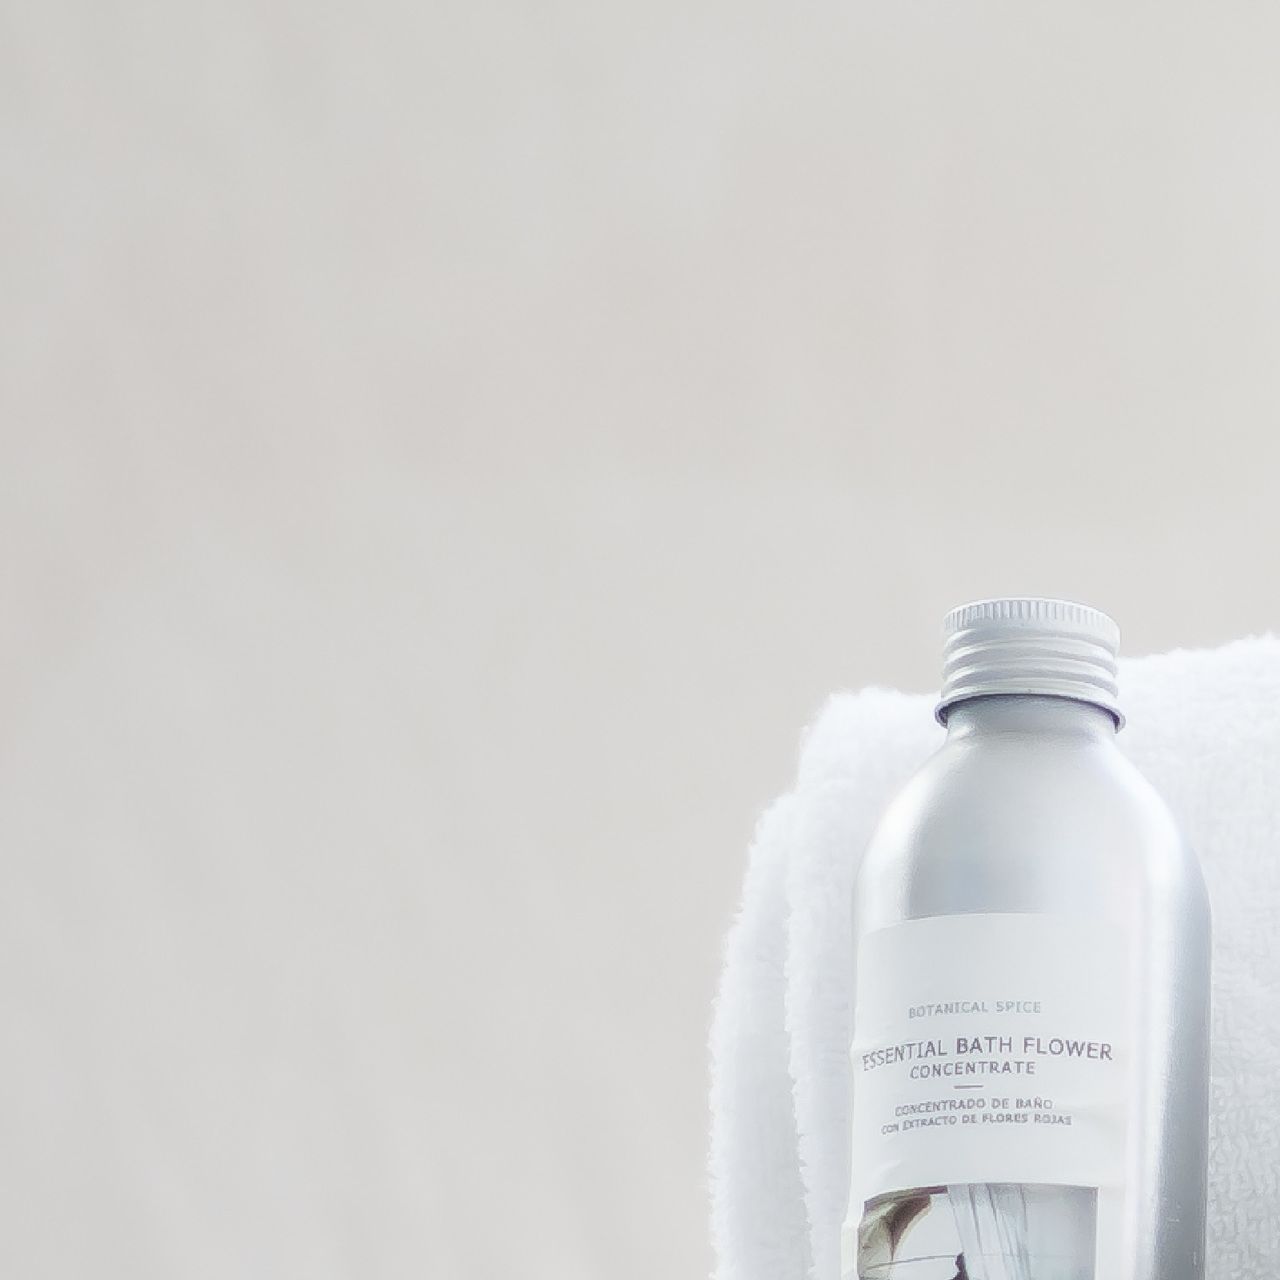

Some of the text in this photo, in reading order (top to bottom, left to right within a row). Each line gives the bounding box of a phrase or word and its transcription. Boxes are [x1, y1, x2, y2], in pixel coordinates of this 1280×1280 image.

[908, 1000, 1041, 1019] BOTANICAL SPICE
[862, 1036, 1114, 1071] ESSENTIAL BATH FLOWER
[909, 1060, 1037, 1080] CONCENTRATE
[894, 1095, 1054, 1117] CONCENTRADO DE BAÑO
[880, 1123, 900, 1135] CON
[901, 1114, 958, 1132] EXTRACTO
[961, 1113, 977, 1124] DE
[981, 1112, 1029, 1124] FLORES
